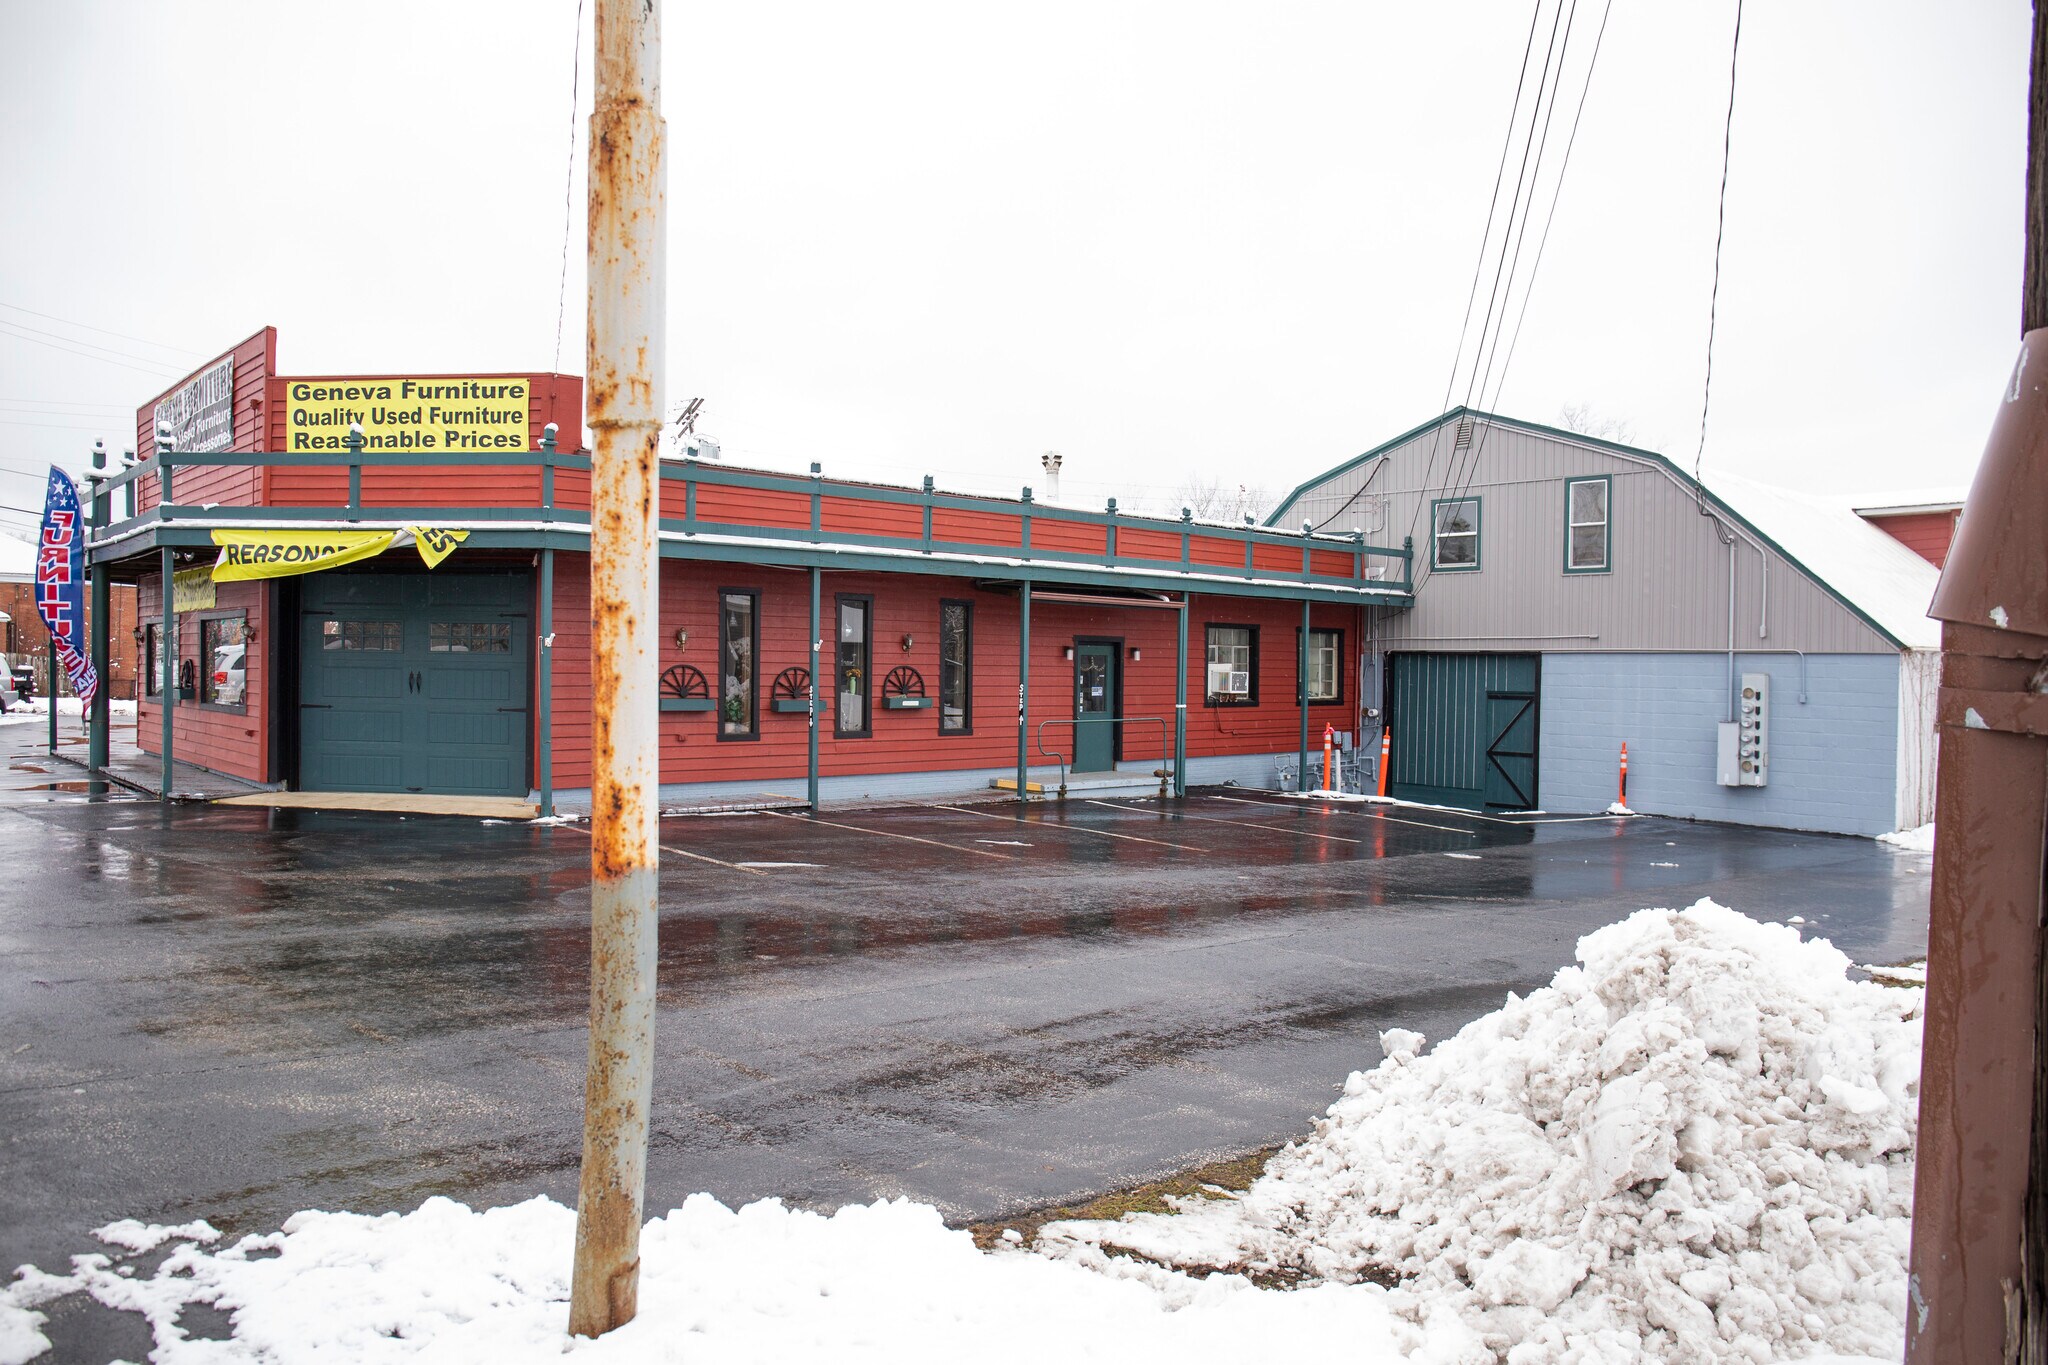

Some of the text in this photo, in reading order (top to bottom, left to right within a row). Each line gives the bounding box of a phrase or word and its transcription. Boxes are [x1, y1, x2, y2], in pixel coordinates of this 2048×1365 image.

[292, 382, 524, 401] Geneva Furniture
[178, 407, 232, 445] Used Furniture
[293, 406, 523, 427] Quality Used Furniture
[445, 430, 522, 448] Prices
[227, 543, 351, 565] REASON
[75, 665, 98, 692] ALE
